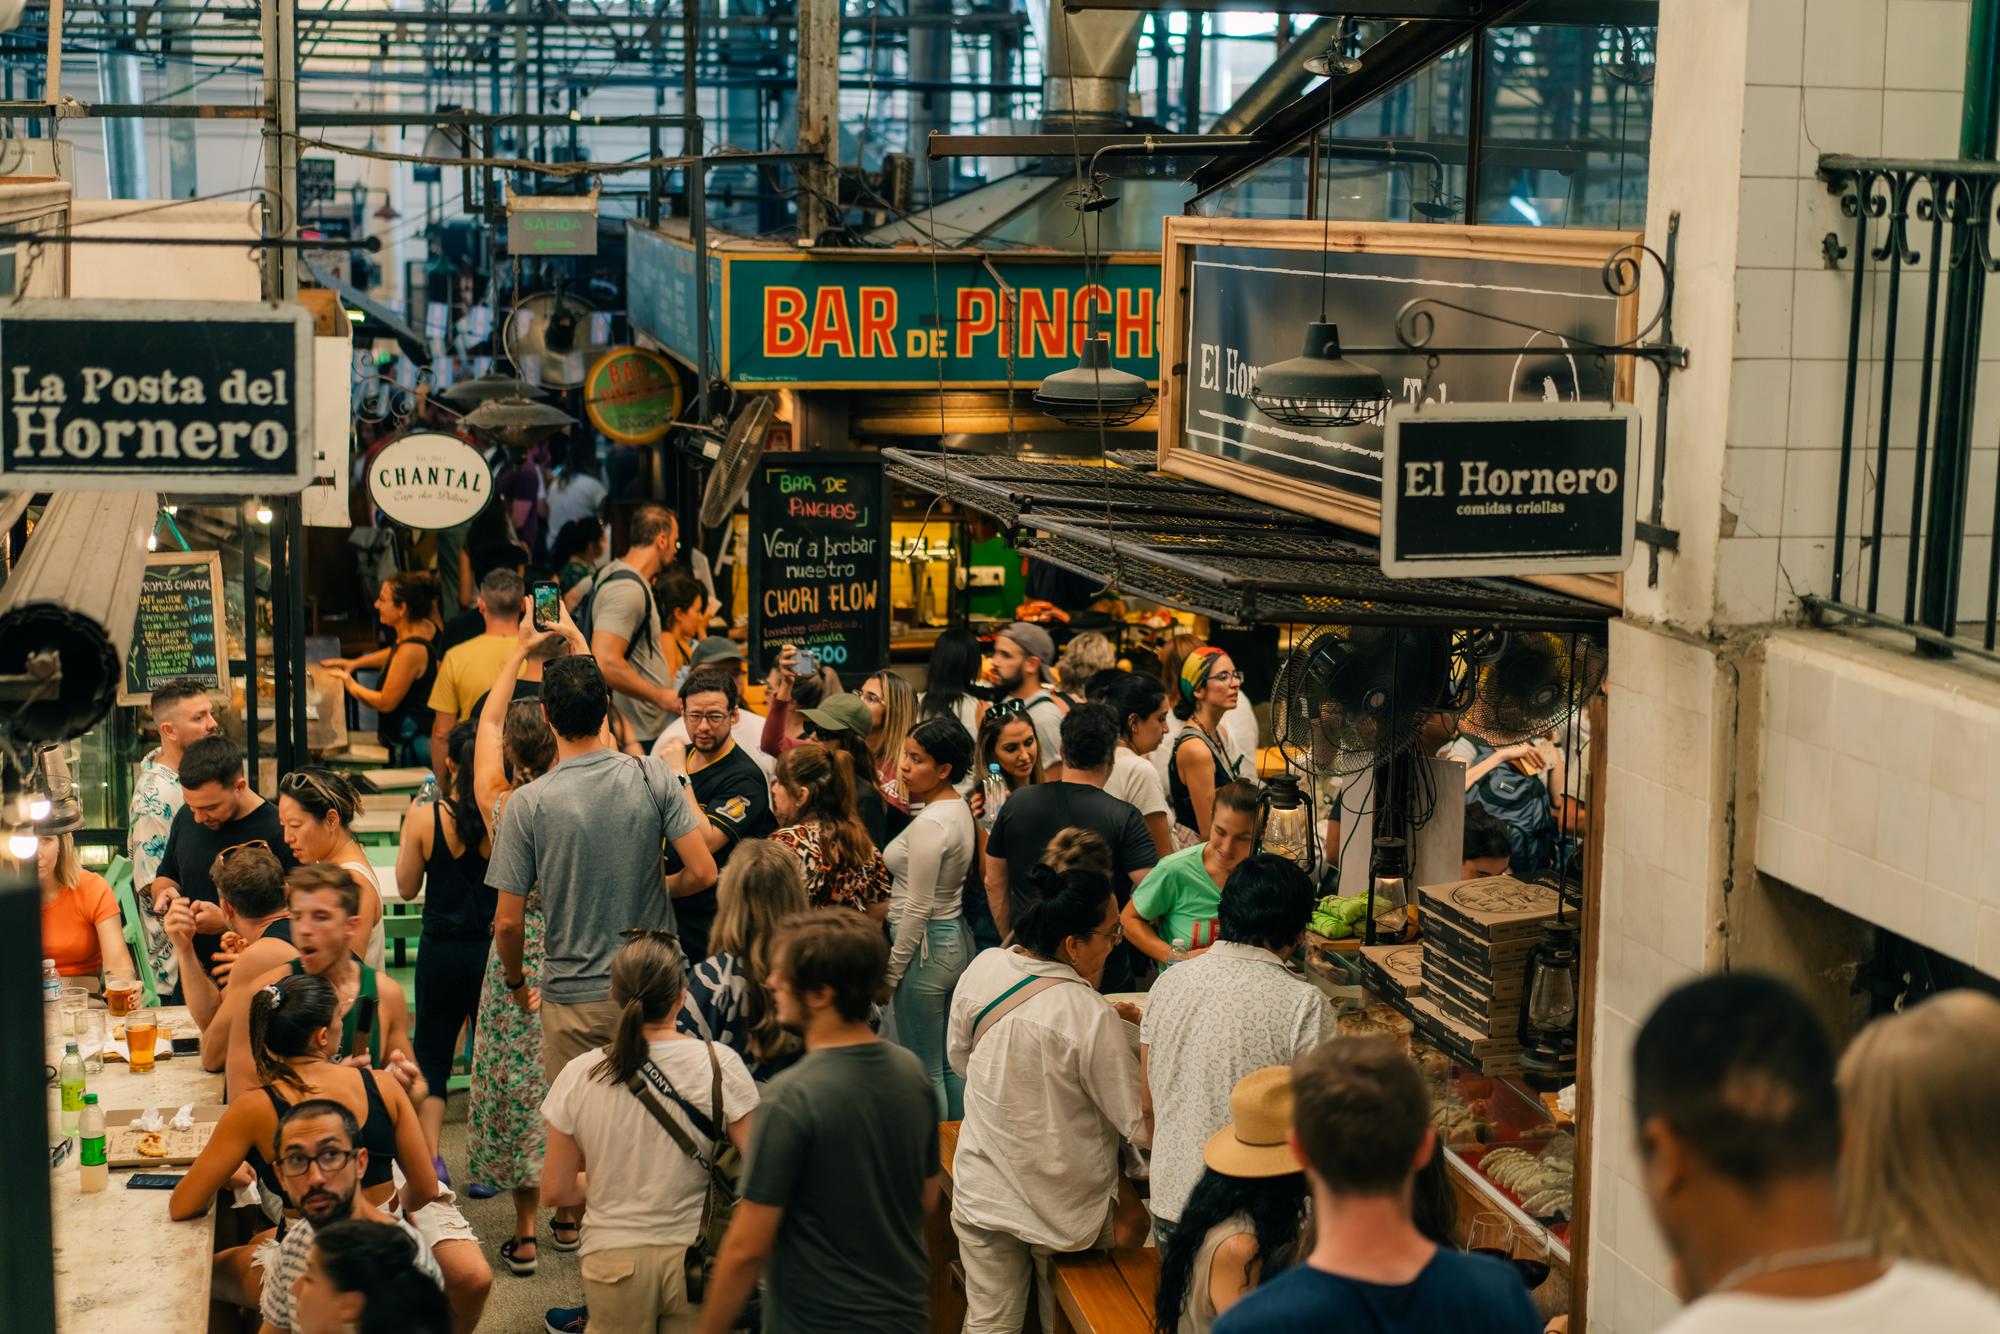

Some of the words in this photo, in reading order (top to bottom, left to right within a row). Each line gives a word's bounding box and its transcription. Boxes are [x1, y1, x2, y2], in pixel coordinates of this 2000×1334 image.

[523, 216, 582, 232] SALIDA
[763, 286, 899, 358] BAR
[907, 329, 947, 358] DE
[956, 286, 1161, 358] PINCH
[1200, 343, 1220, 391] El
[12, 366, 67, 402] La
[81, 366, 206, 404] Posta
[219, 369, 289, 405] del
[12, 405, 289, 460] Hornero
[380, 467, 480, 492] CHANTAL
[780, 475, 816, 493] BAR
[822, 477, 847, 493] DE
[1404, 461, 1445, 497] El
[1459, 461, 1618, 496] Hornero
[788, 497, 859, 520] PINCHOS
[1456, 502, 1512, 516] comidas
[1515, 501, 1565, 515] criollas
[763, 528, 802, 559] Vení
[806, 541, 818, 557] a
[824, 535, 877, 563] probar
[174, 579, 211, 590] CHANTAL
[786, 561, 856, 579] nuestro
[764, 586, 820, 617] CHORI
[828, 580, 878, 612] FLOW
[643, 1061, 673, 1094] SONY
